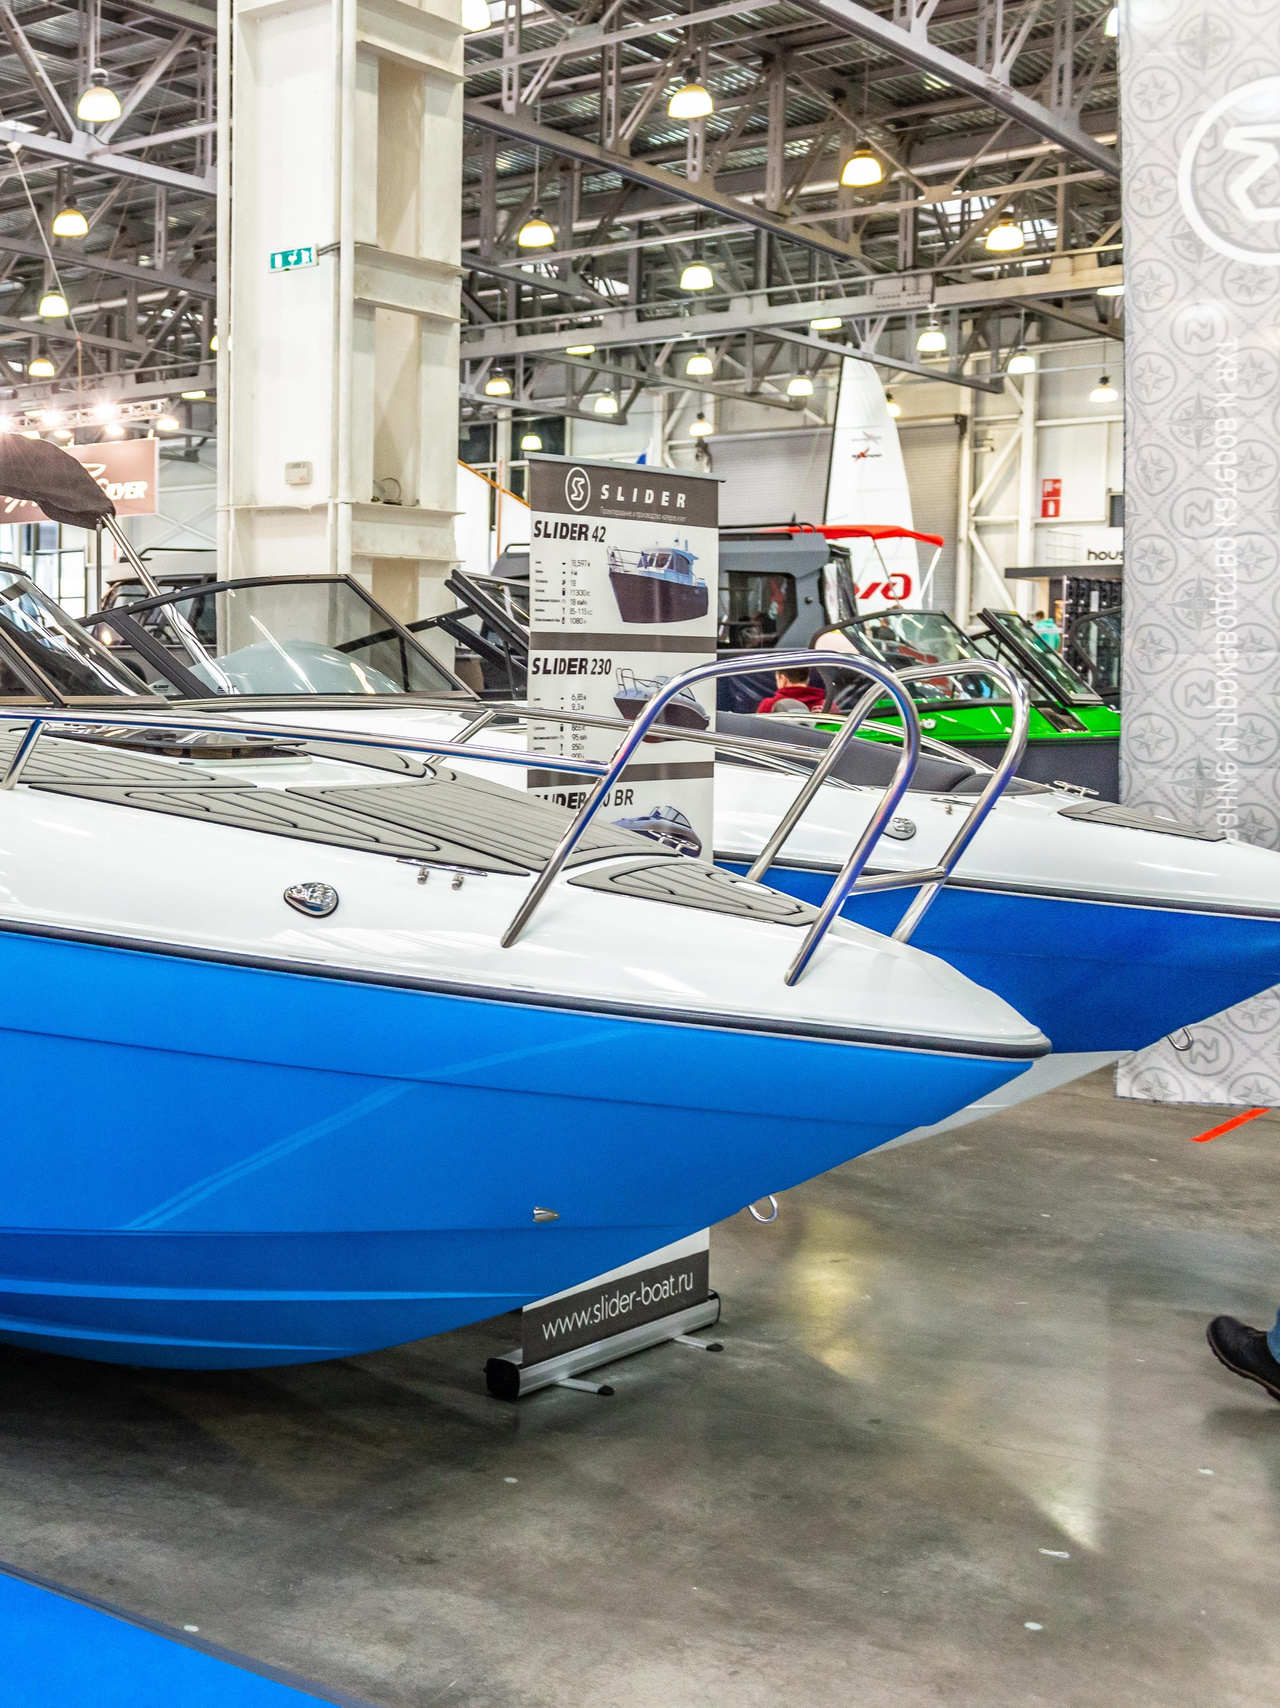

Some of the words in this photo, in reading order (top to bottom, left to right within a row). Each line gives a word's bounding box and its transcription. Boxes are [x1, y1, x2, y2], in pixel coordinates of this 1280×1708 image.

[600, 484, 687, 509] SLIDER
[533, 520, 589, 541] SLIDER
[591, 525, 607, 543] 42
[531, 657, 589, 675] SLIDER
[590, 658, 612, 675] 230
[614, 788, 634, 807] BR
[542, 1272, 694, 1341] www.slider-boat.ru
